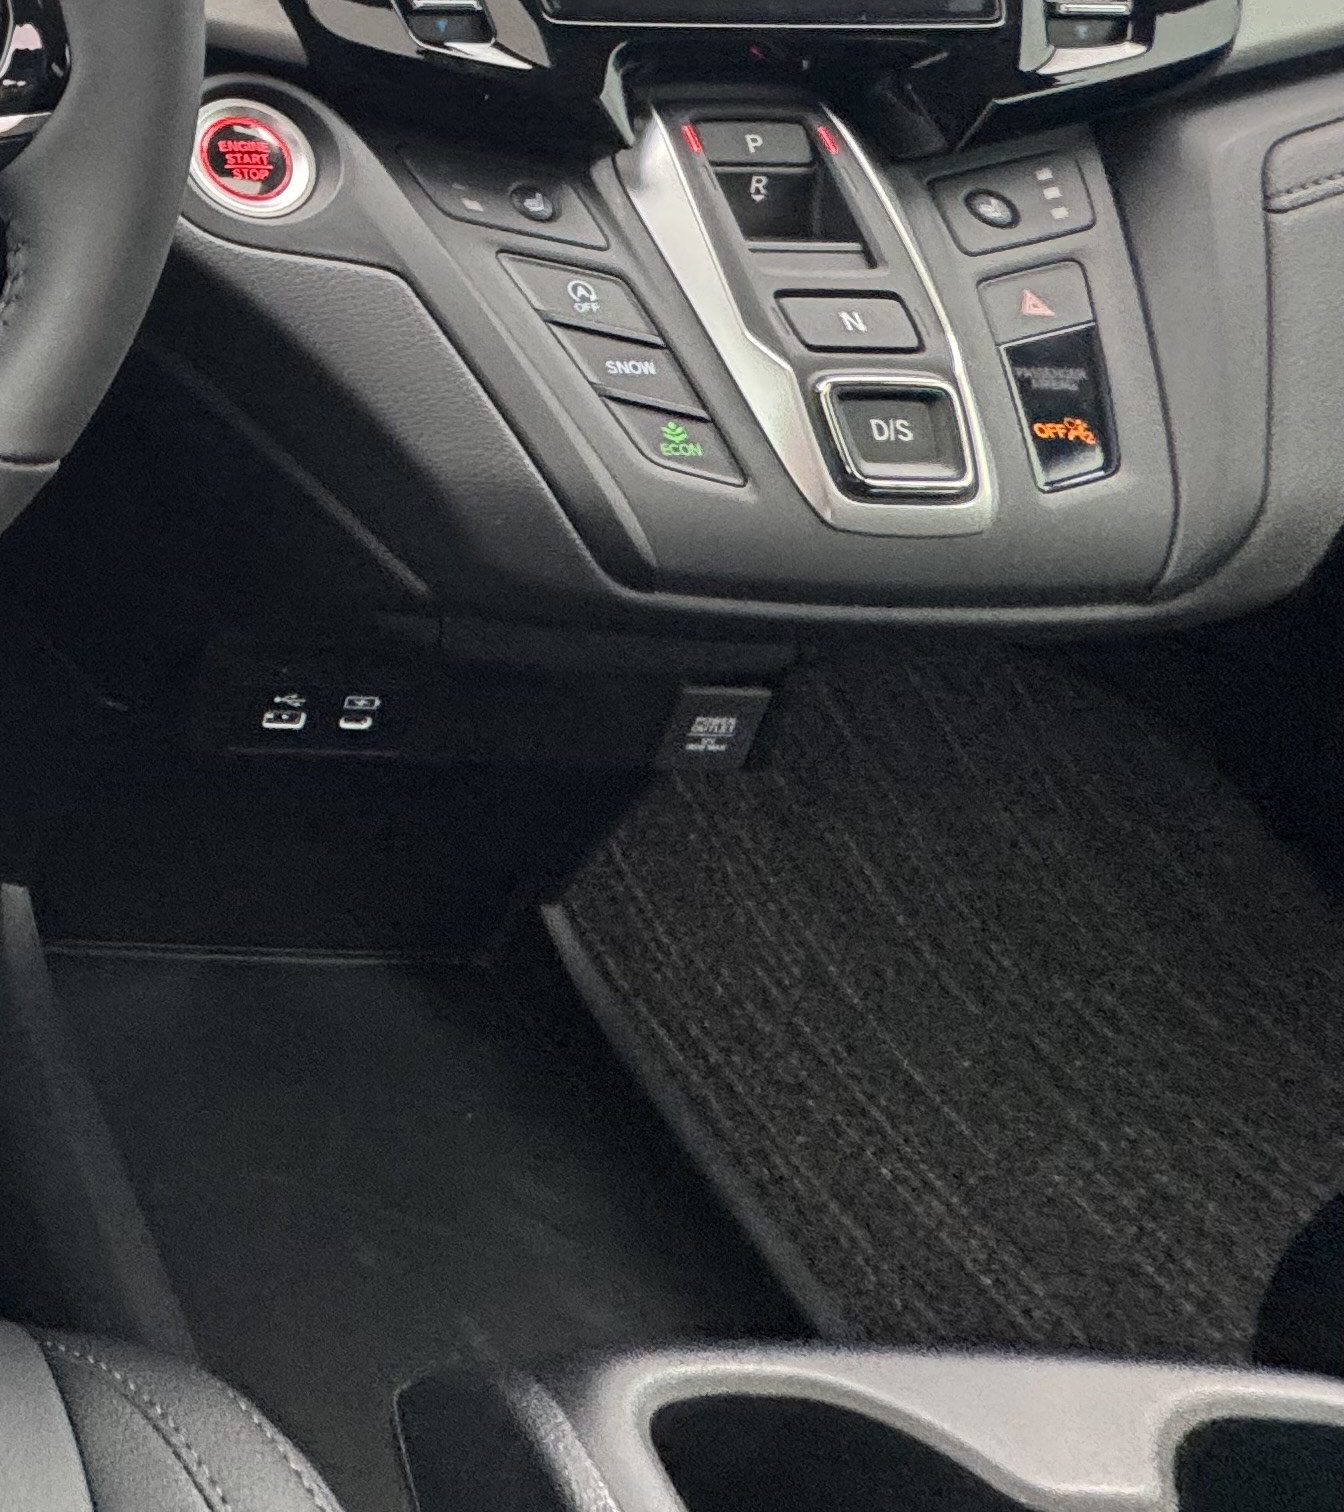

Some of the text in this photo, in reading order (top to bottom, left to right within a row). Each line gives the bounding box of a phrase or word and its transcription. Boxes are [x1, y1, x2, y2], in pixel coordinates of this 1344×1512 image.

[217, 139, 270, 153] ENGINE
[744, 133, 764, 154] P
[224, 153, 269, 166] START
[232, 168, 270, 181] STOP
[749, 174, 768, 195] R
[573, 301, 600, 313] OFF
[838, 311, 868, 334] N
[605, 359, 657, 375] SNOW
[868, 417, 915, 442] D/S
[1033, 421, 1067, 439] OFF
[660, 442, 704, 457] ECON
